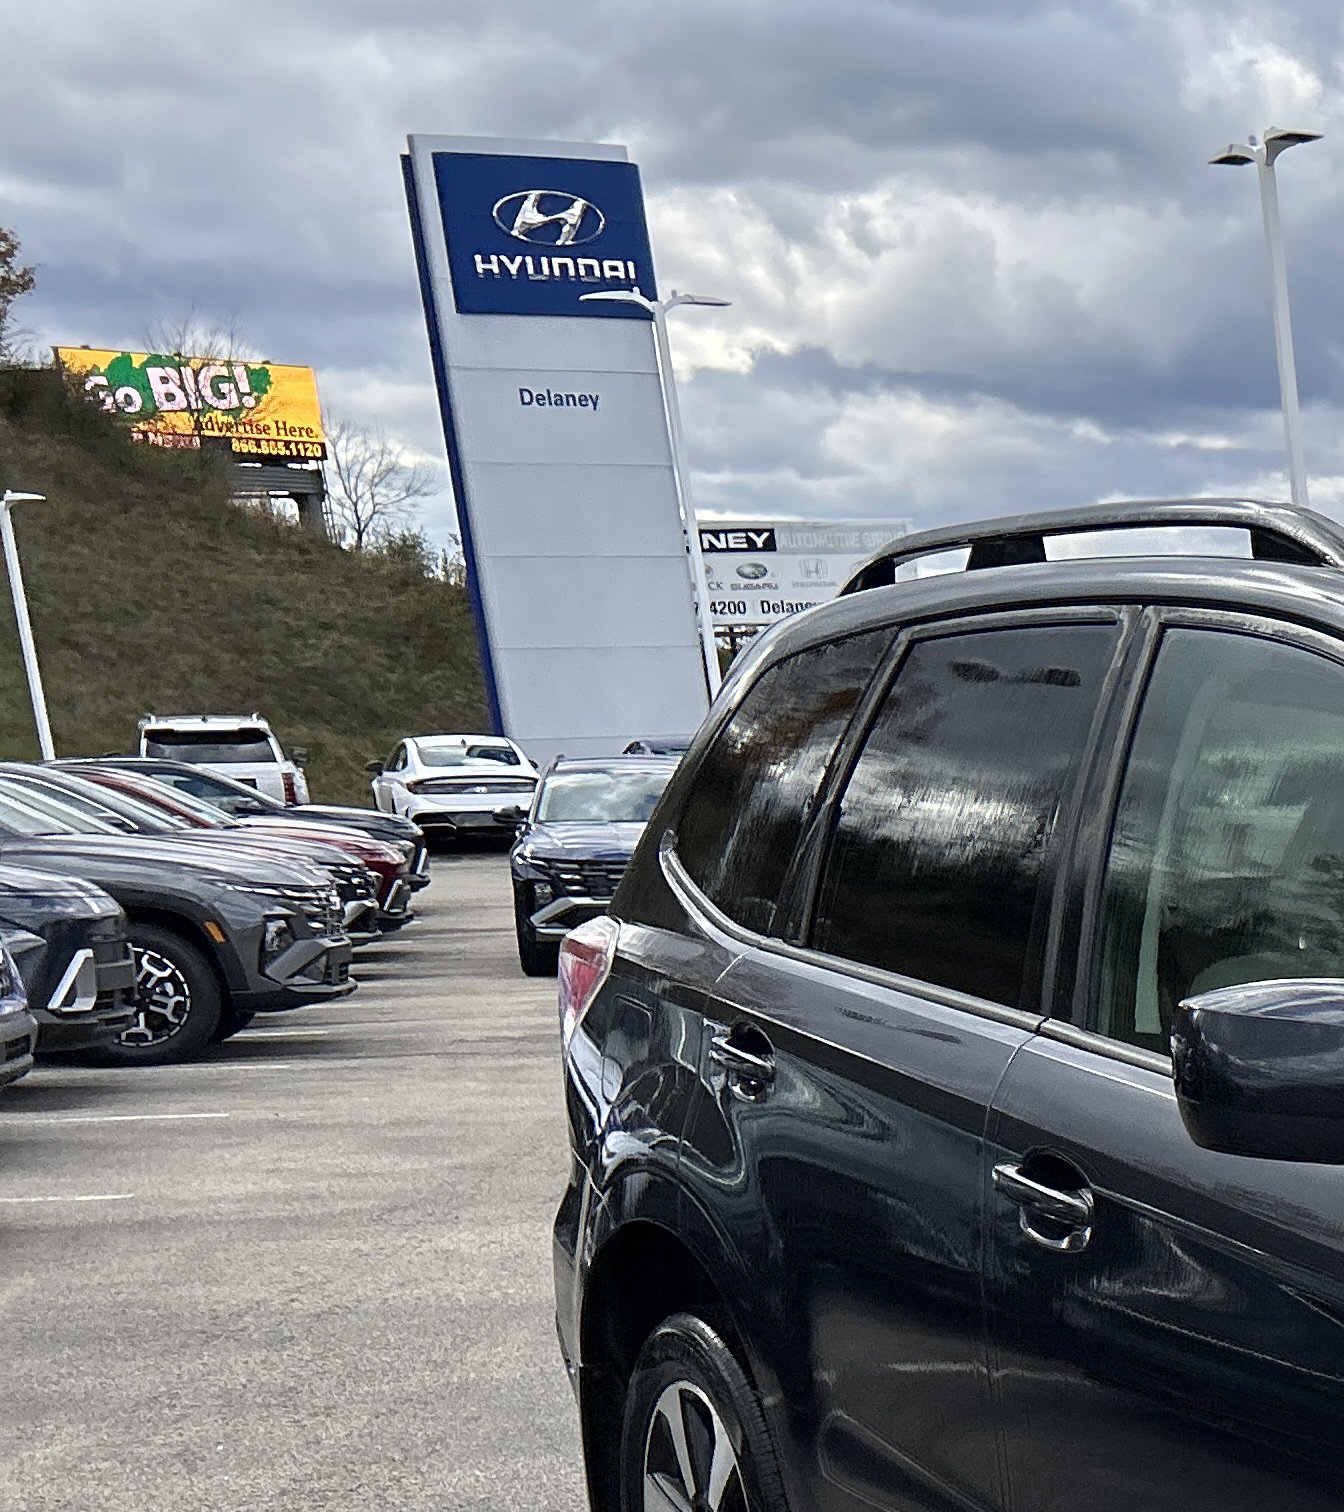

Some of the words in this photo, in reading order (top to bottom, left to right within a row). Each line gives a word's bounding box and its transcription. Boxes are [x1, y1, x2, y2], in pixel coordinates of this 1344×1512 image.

[473, 253, 637, 280] HYUNDAI
[145, 365, 257, 412] BIG!
[519, 387, 600, 411] Delaney
[274, 420, 319, 440] Here.
[761, 600, 820, 615] Delane
